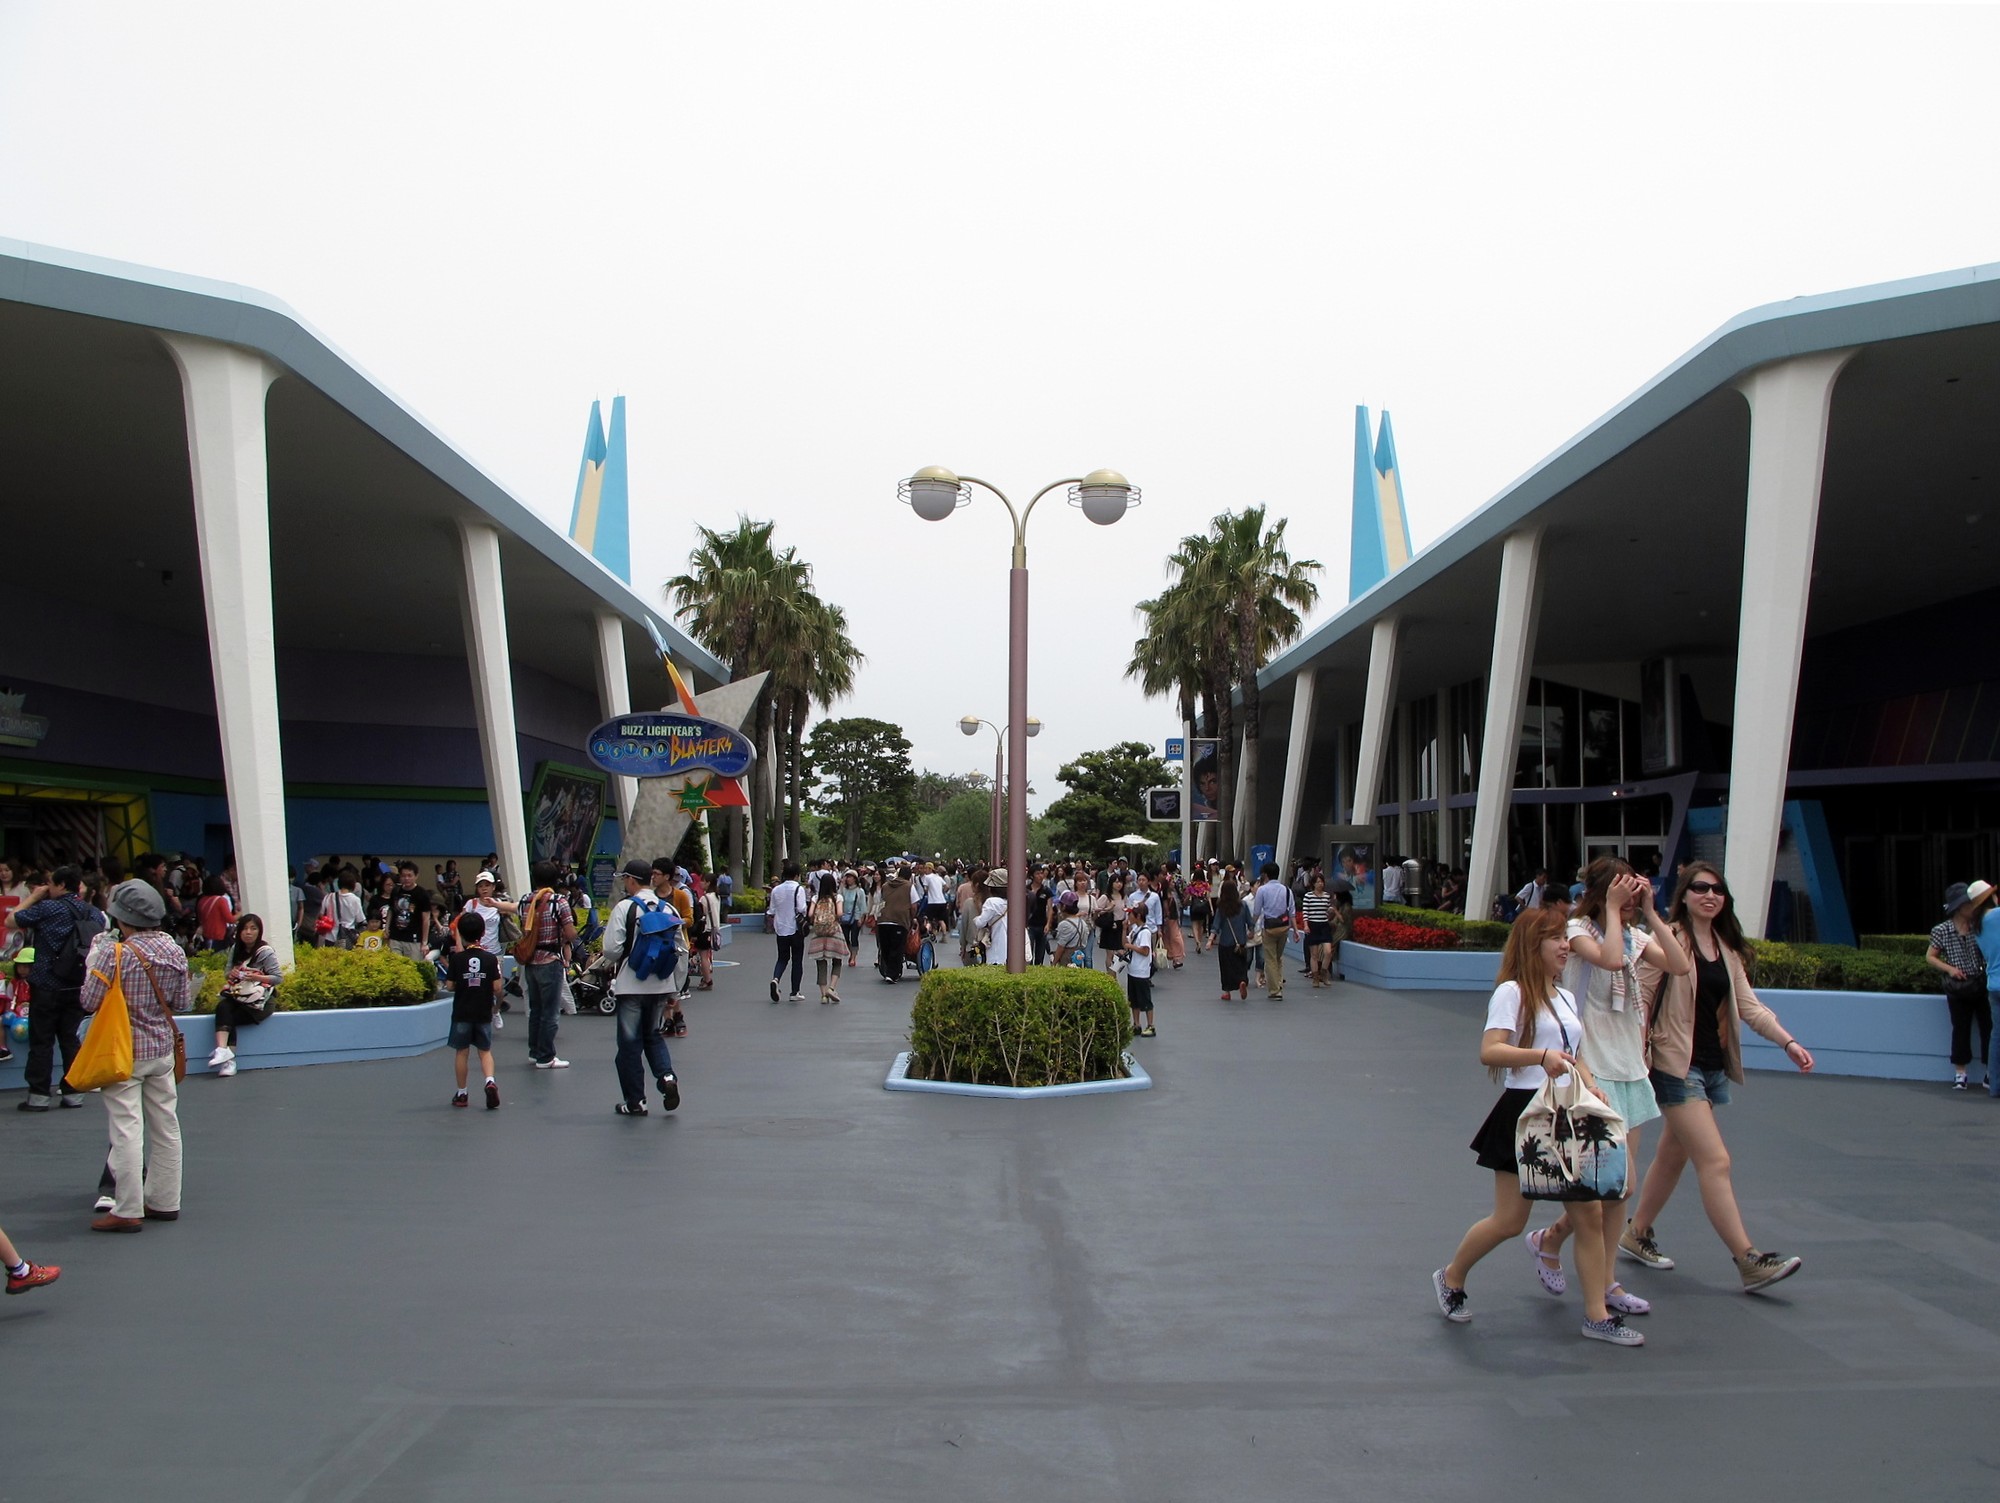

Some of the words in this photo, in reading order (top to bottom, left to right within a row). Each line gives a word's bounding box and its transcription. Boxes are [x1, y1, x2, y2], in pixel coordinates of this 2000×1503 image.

[621, 725, 643, 736] BUZZ
[647, 725, 702, 736] LIGHTYEAR'S
[597, 741, 666, 759] ASTRO
[670, 735, 732, 766] BLASTERS
[468, 957, 480, 972] 9
